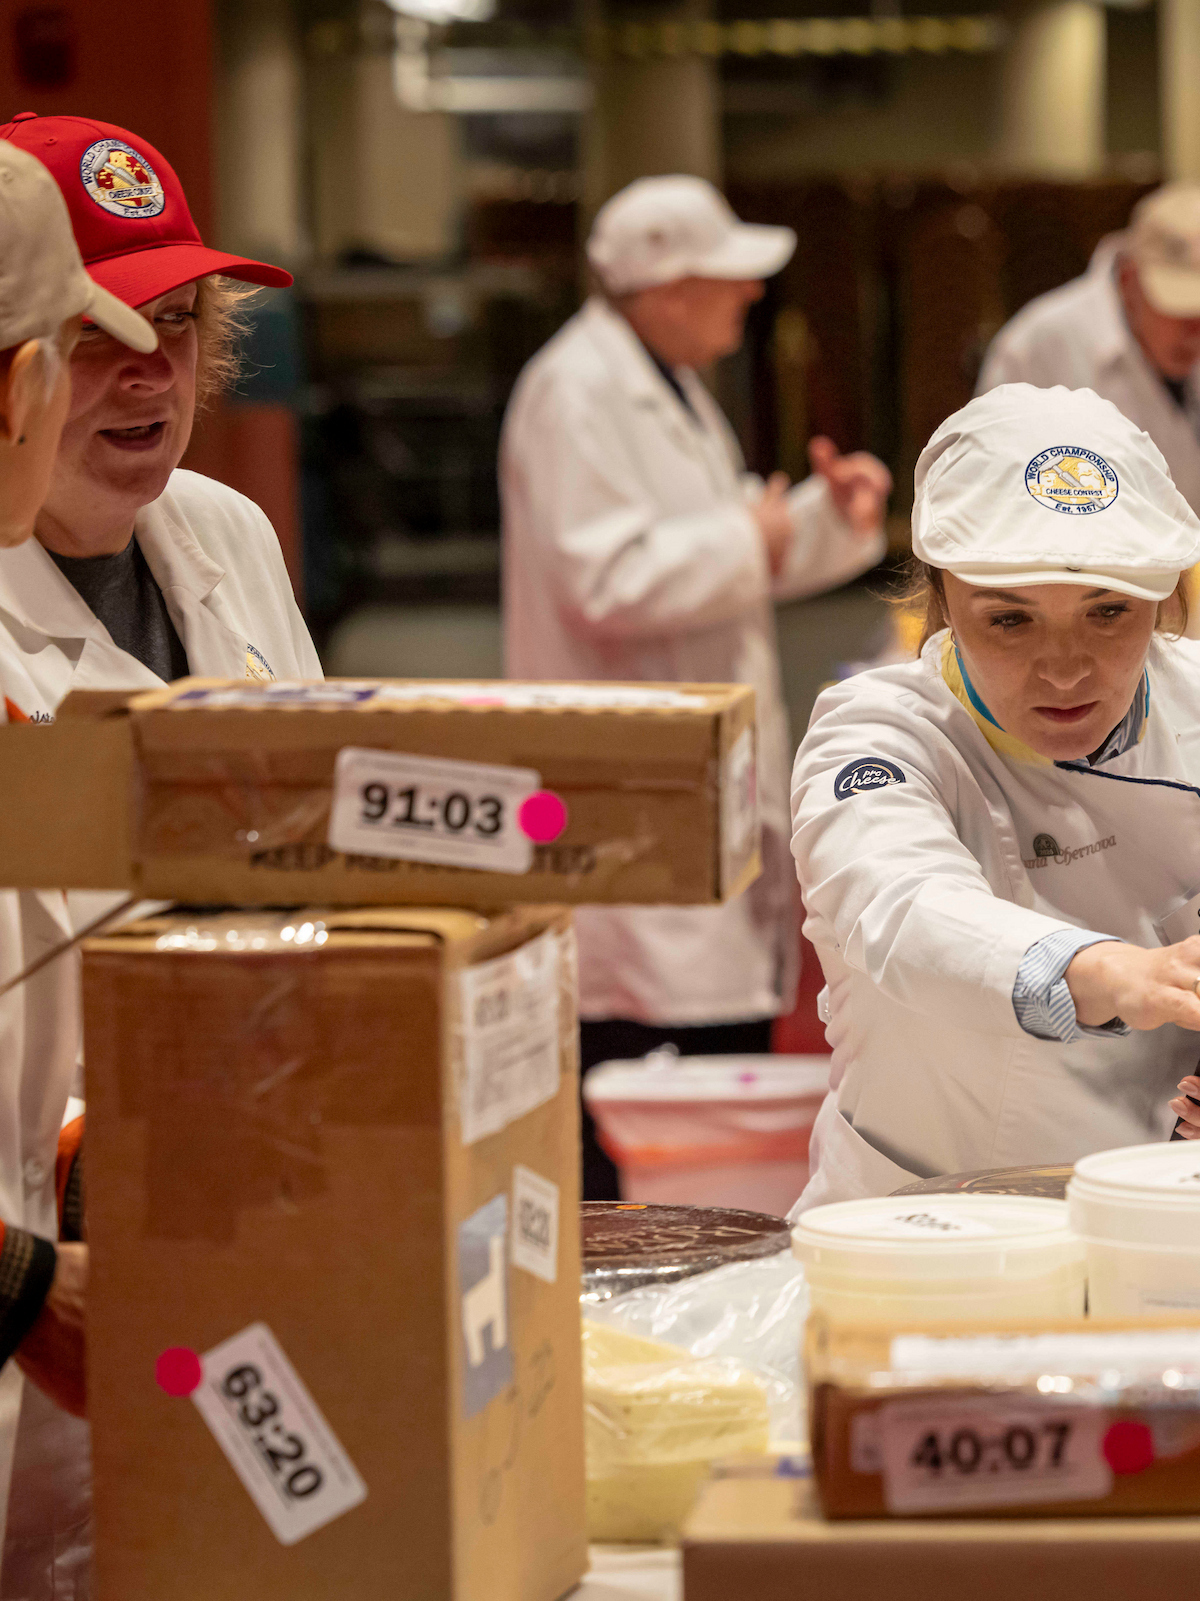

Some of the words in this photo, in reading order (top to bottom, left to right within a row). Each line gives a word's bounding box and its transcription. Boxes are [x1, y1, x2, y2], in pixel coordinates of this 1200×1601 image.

[82, 152, 96, 185] WORLD
[1027, 453, 1049, 480] WORLD
[1049, 448, 1115, 482] CHAMPIONSHIP
[1045, 488, 1073, 496] CHEESE
[1073, 488, 1103, 497] CONTEST
[1055, 503, 1073, 513] Est.
[839, 772, 900, 792] Cheese
[863, 770, 882, 779] pro
[361, 781, 503, 838] 91:03
[222, 1362, 323, 1499] 63:20
[910, 1419, 1072, 1476] 40:07
